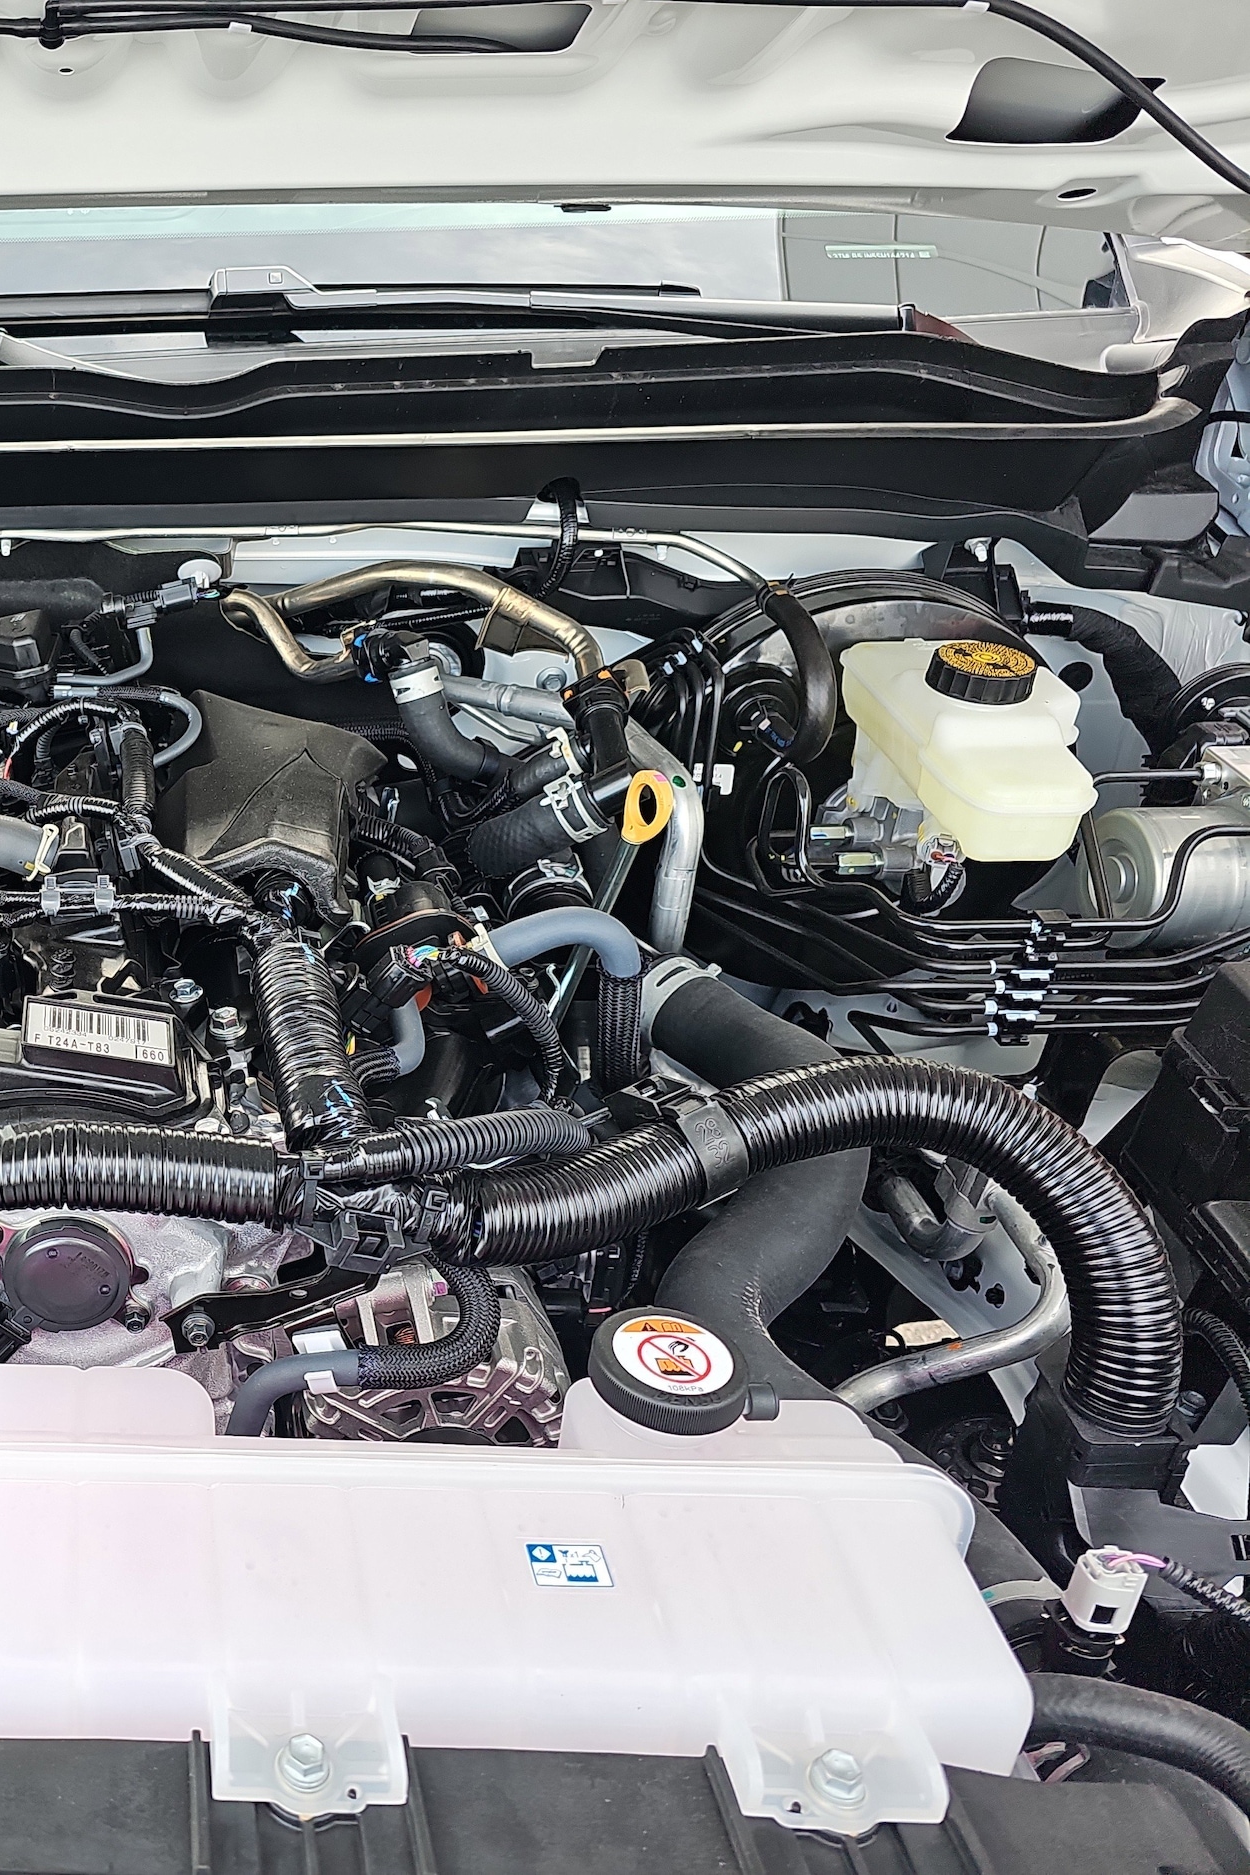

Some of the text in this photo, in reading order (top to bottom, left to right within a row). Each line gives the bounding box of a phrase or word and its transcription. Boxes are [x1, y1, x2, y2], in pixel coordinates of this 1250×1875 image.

[34, 1032, 110, 1054] F T24A-T83
[141, 1049, 165, 1062] 660
[667, 1384, 705, 1393] 108kPa
